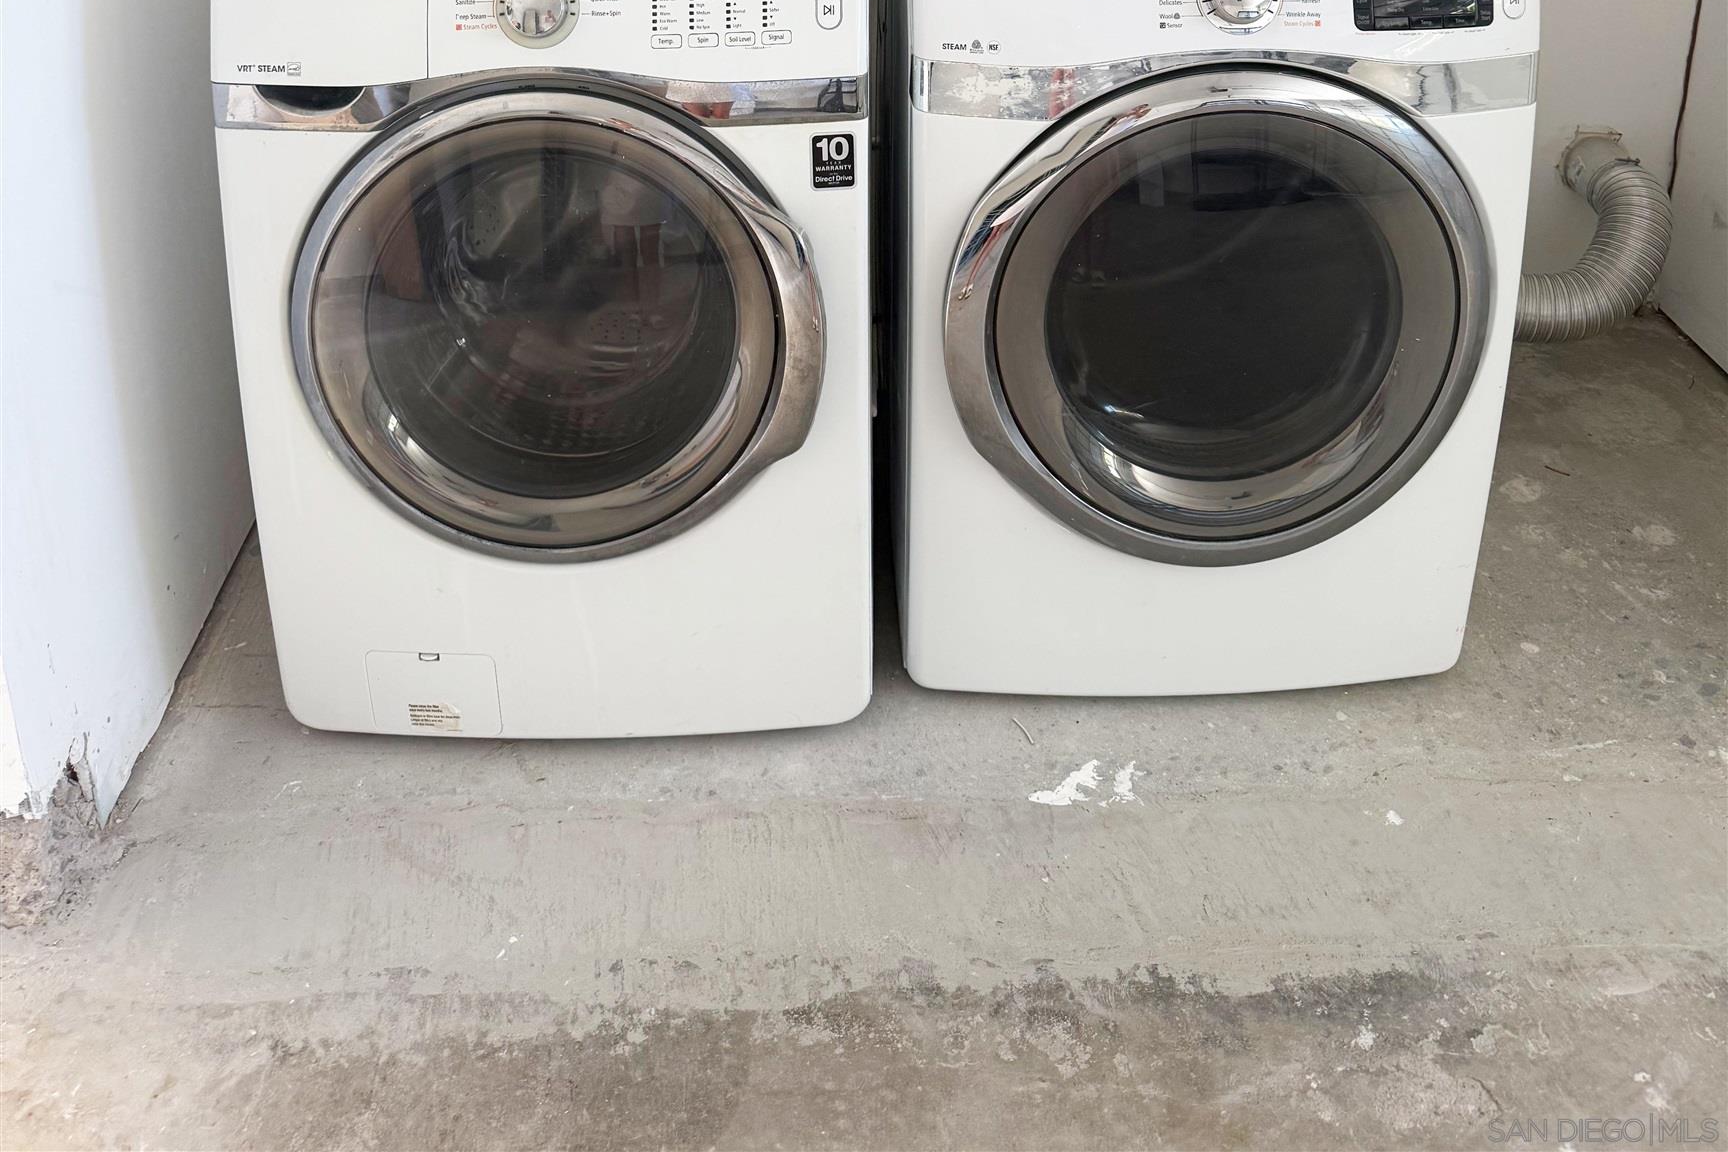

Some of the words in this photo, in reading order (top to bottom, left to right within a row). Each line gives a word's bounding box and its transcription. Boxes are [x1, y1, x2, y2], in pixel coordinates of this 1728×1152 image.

[768, 34, 785, 42] Signal
[942, 42, 967, 50] STEAM
[257, 64, 286, 73] STEAM
[816, 136, 849, 162] 10
[815, 164, 852, 172] WARRANTY
